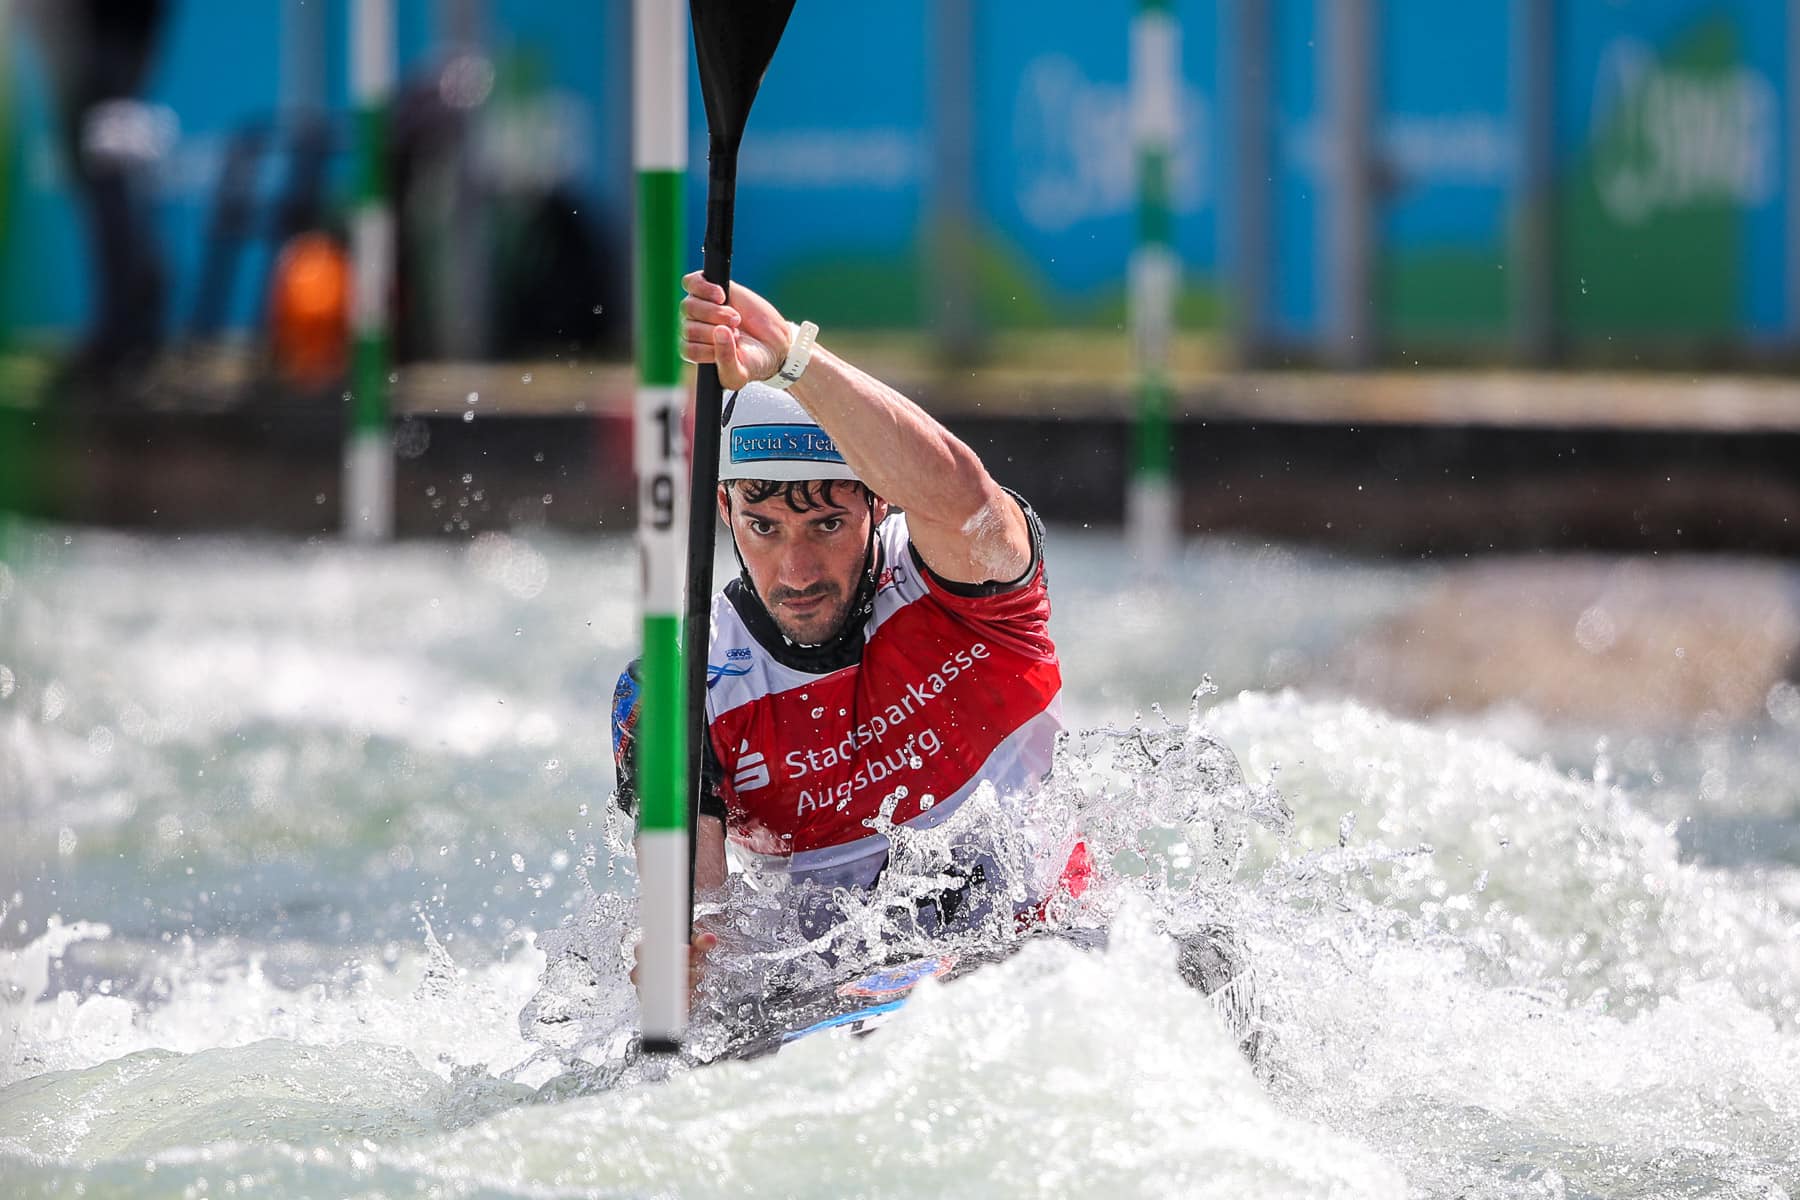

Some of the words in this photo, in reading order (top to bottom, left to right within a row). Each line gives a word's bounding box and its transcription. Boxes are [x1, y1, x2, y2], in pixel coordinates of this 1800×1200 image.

[734, 432, 798, 453] Percia's
[803, 433, 840, 452] Tea
[797, 728, 941, 816] Augsburg
